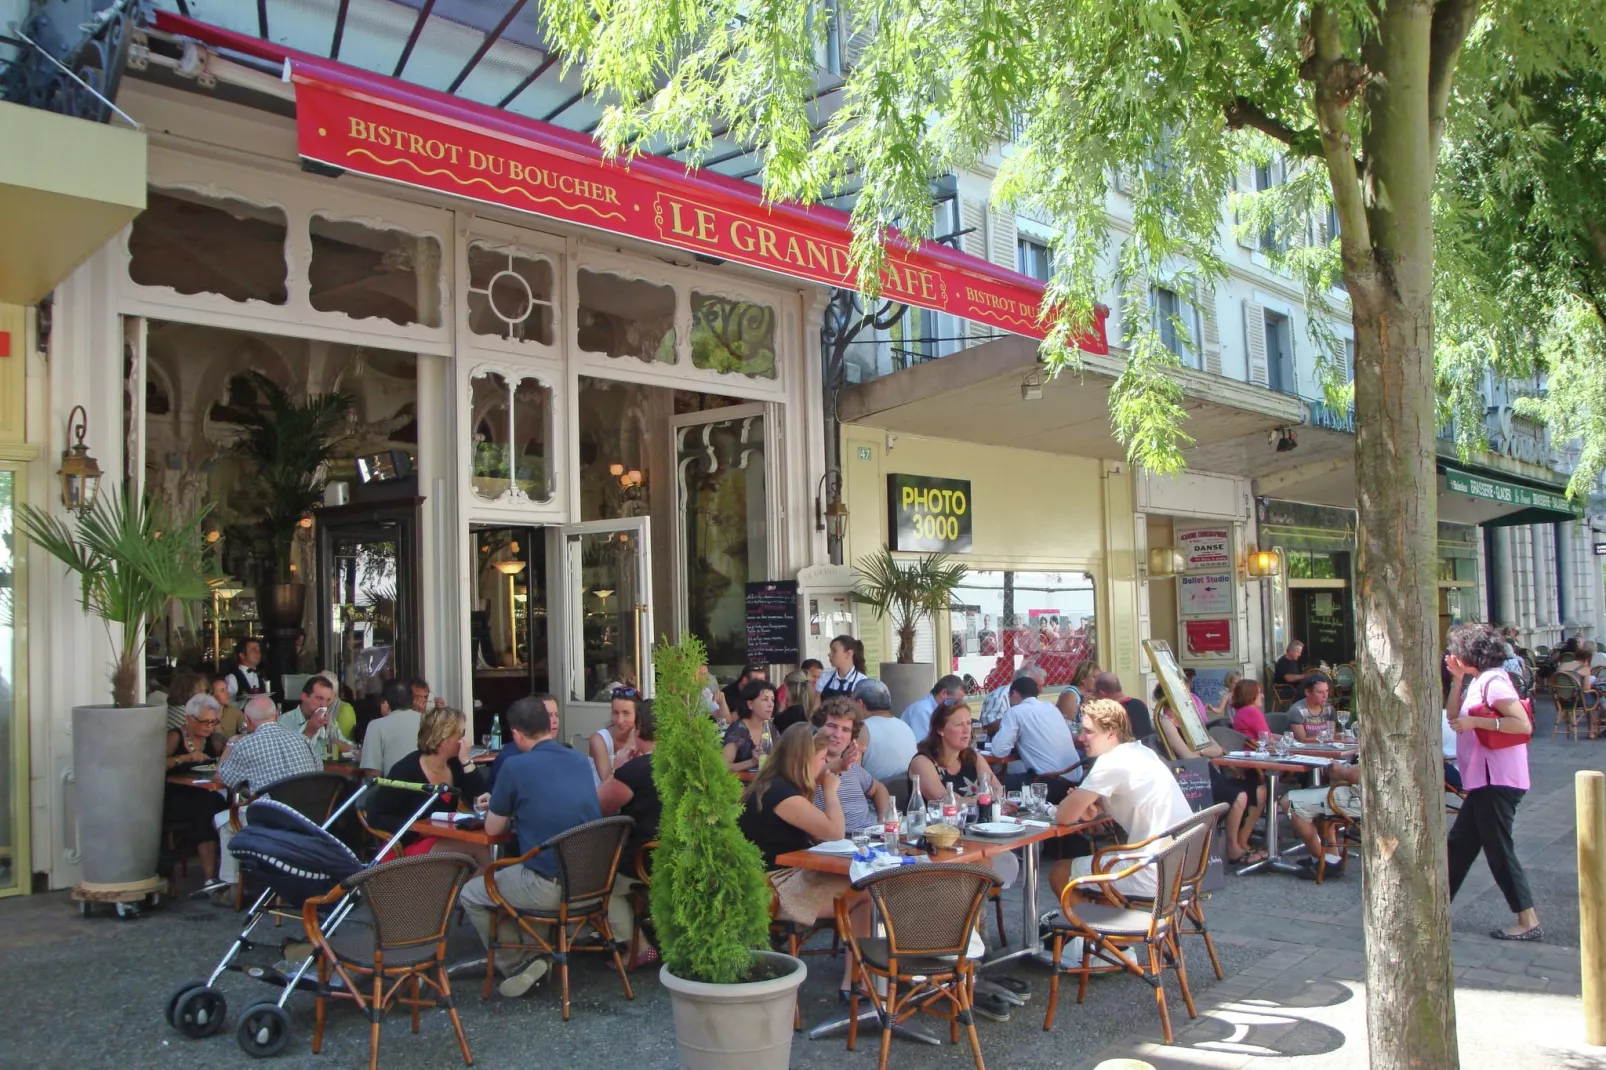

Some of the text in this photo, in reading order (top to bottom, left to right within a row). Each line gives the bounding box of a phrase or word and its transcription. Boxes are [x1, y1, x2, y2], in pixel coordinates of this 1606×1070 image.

[347, 116, 622, 206] BISTROT DU BOUCHER
[668, 201, 937, 302] LE GRAND AFÉ
[966, 287, 1035, 319] BISTROT DU
[902, 486, 966, 515] PHOTO
[912, 514, 958, 540] 3000
[1194, 543, 1224, 552] DANSE
[1182, 574, 1229, 585] Ballet Studio
